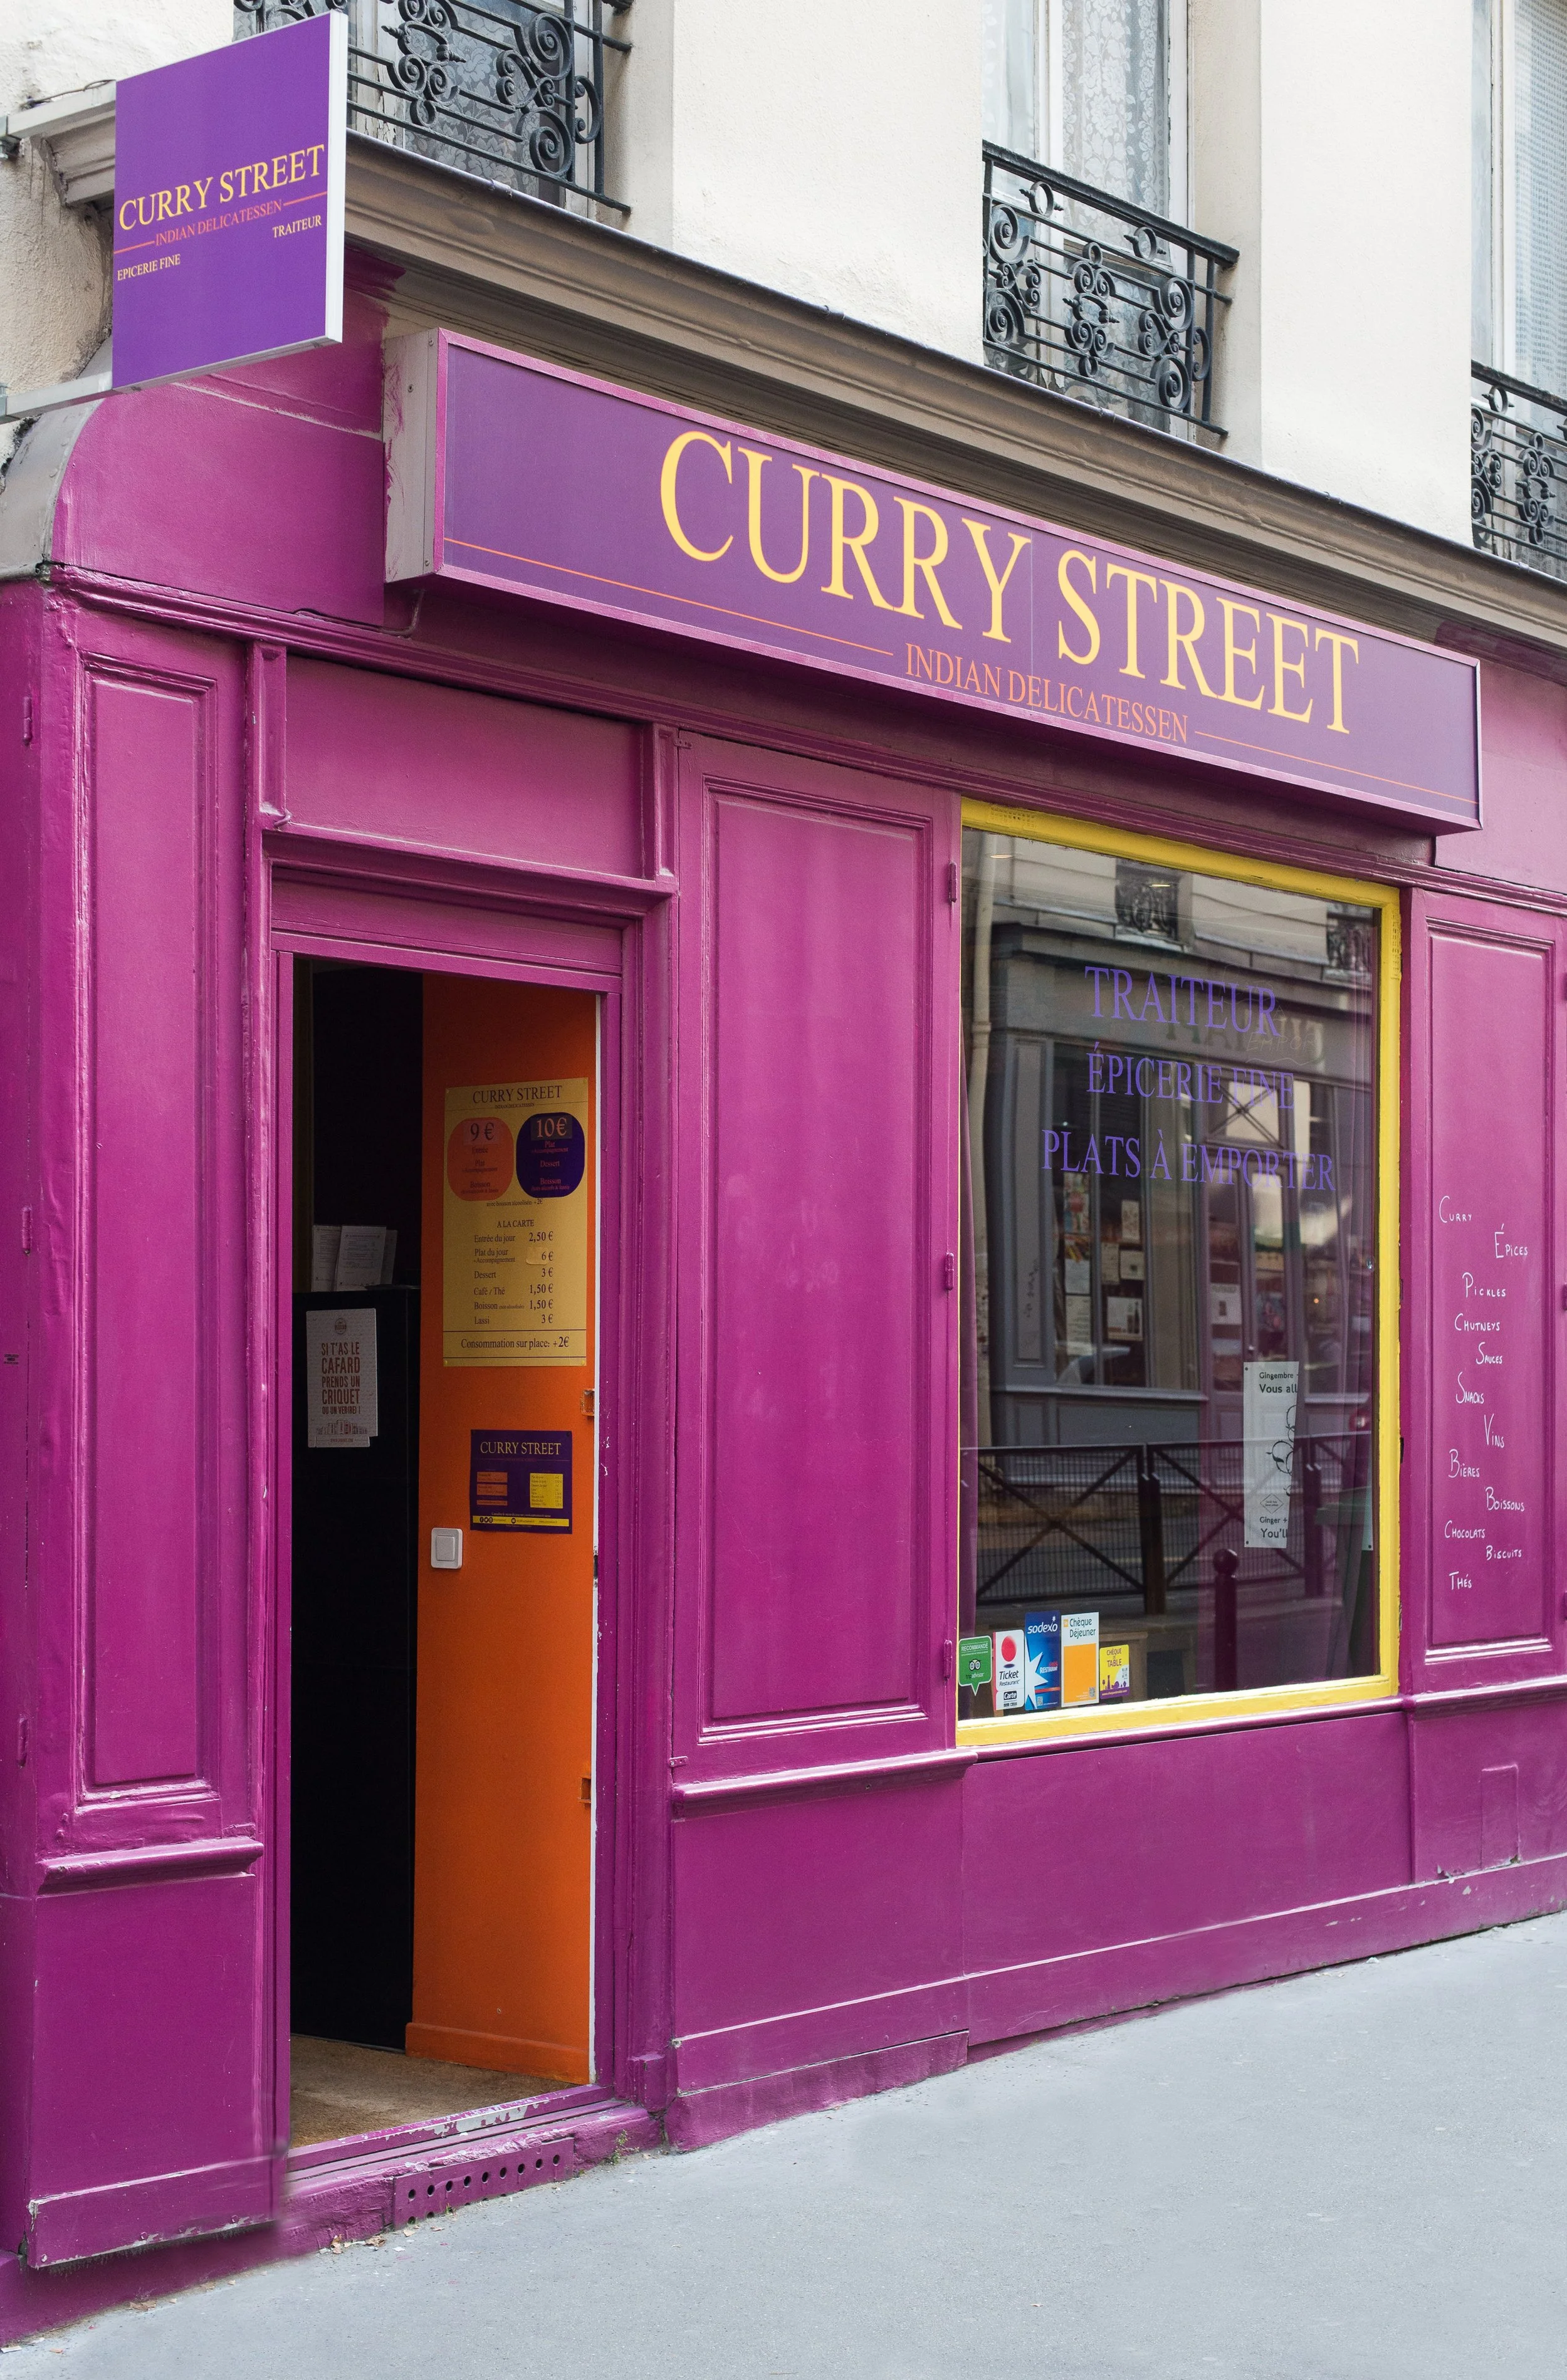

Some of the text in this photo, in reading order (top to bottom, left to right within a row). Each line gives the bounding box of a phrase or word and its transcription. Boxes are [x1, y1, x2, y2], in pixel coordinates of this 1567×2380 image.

[118, 144, 325, 231] CURRY STREET
[155, 199, 282, 246] INDIAN DELICATESSEN
[272, 214, 322, 238] TRAITEUR
[117, 253, 181, 281] EPICERIE FINE
[660, 431, 1359, 735] CURRY STREET
[905, 642, 1188, 744] INDIAN DELICATESSEN
[1084, 966, 1281, 1037] TRAITEUR
[1086, 1042, 1294, 1109] ÉPICERIE FINE
[473, 1085, 562, 1104] CURRY STREET
[470, 1122, 495, 1141] 9 €
[1042, 1129, 1336, 1192] PLATS À EMPORTER
[512, 1219, 534, 1227] CARTE
[474, 1234, 493, 1243] Entrée
[503, 1234, 516, 1244] jour
[529, 1230, 553, 1242] 2,50 €
[474, 1248, 486, 1256] Plat
[496, 1247, 508, 1257] jour
[542, 1251, 553, 1261] 6 €
[474, 1271, 496, 1279] Dessert
[542, 1267, 553, 1277] 3 €
[473, 1287, 488, 1296] Café
[493, 1286, 505, 1295] Thé
[530, 1283, 553, 1295] 1,50 €
[474, 1301, 498, 1309] Boisson
[530, 1299, 553, 1311] 1,50 €
[474, 1316, 490, 1324] Lassi
[541, 1313, 553, 1324] 3 €
[321, 1341, 360, 1356] SI T'AS LE
[461, 1338, 515, 1349] Consommation
[516, 1340, 527, 1348] sur
[529, 1338, 550, 1350] place:
[322, 1356, 360, 1375] CAFARD
[322, 1375, 360, 1388] PRENDS UN
[1259, 1371, 1294, 1380] Gingembre
[1259, 1383, 1282, 1393] Vous
[322, 1388, 360, 1405] CRIQUET
[322, 1406, 329, 1415] OU
[330, 1406, 337, 1415] UN
[480, 1441, 562, 1455] CURRY STREET
[1259, 1516, 1281, 1525] Ginger
[1027, 1622, 1058, 1634] sodexo
[1069, 1617, 1093, 1628] Chèque
[1069, 1628, 1096, 1639] Déjeuner
[1107, 1659, 1122, 1668] TABLE
[999, 1670, 1019, 1680] Ticket
